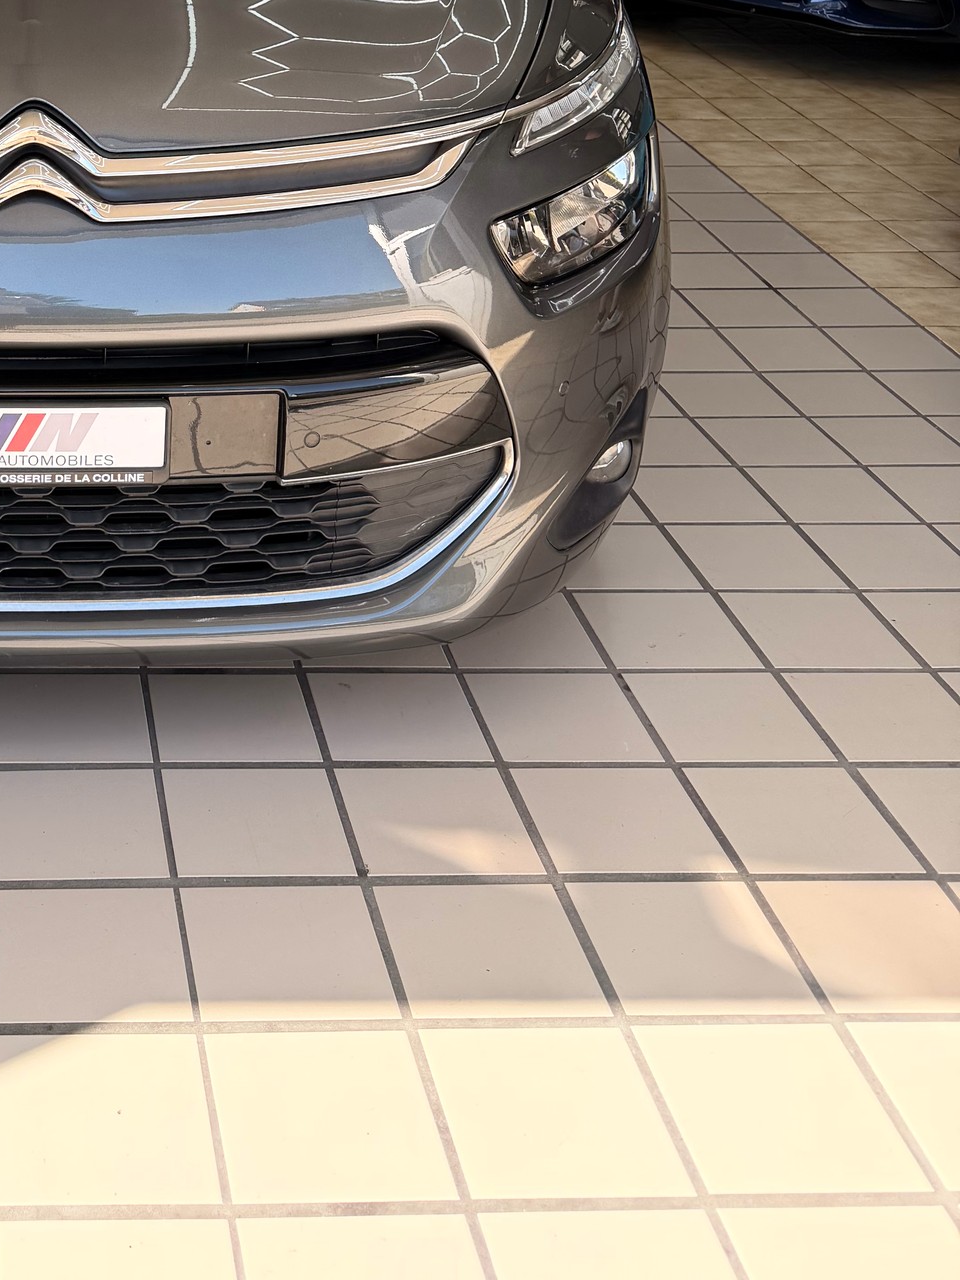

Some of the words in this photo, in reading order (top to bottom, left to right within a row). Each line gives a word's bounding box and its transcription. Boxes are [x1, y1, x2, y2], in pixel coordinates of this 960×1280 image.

[55, 473, 71, 483] DE
[74, 473, 90, 483] LA
[92, 472, 145, 483] COLLINE
